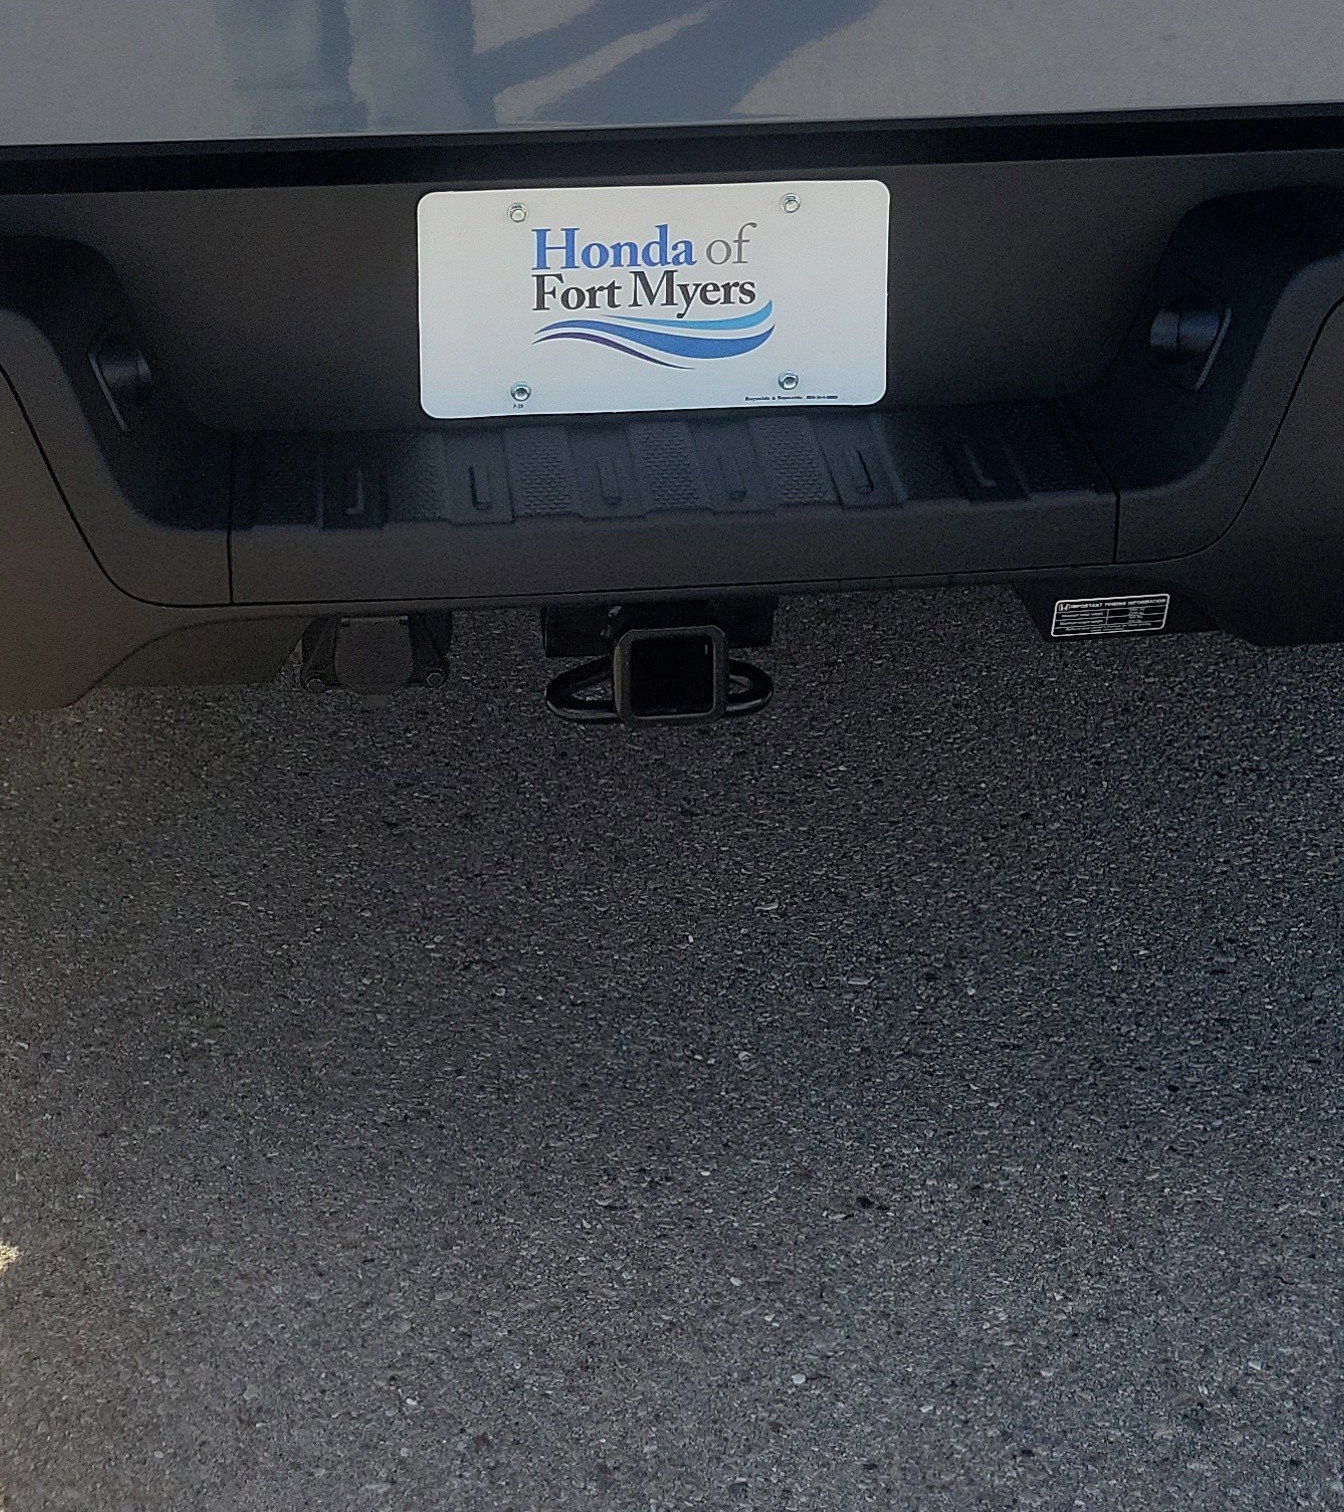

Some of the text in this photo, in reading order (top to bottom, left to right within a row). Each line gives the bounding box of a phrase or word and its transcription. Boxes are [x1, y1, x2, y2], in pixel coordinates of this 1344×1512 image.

[531, 222, 758, 271] Honda of
[531, 269, 757, 319] Fort Myers
